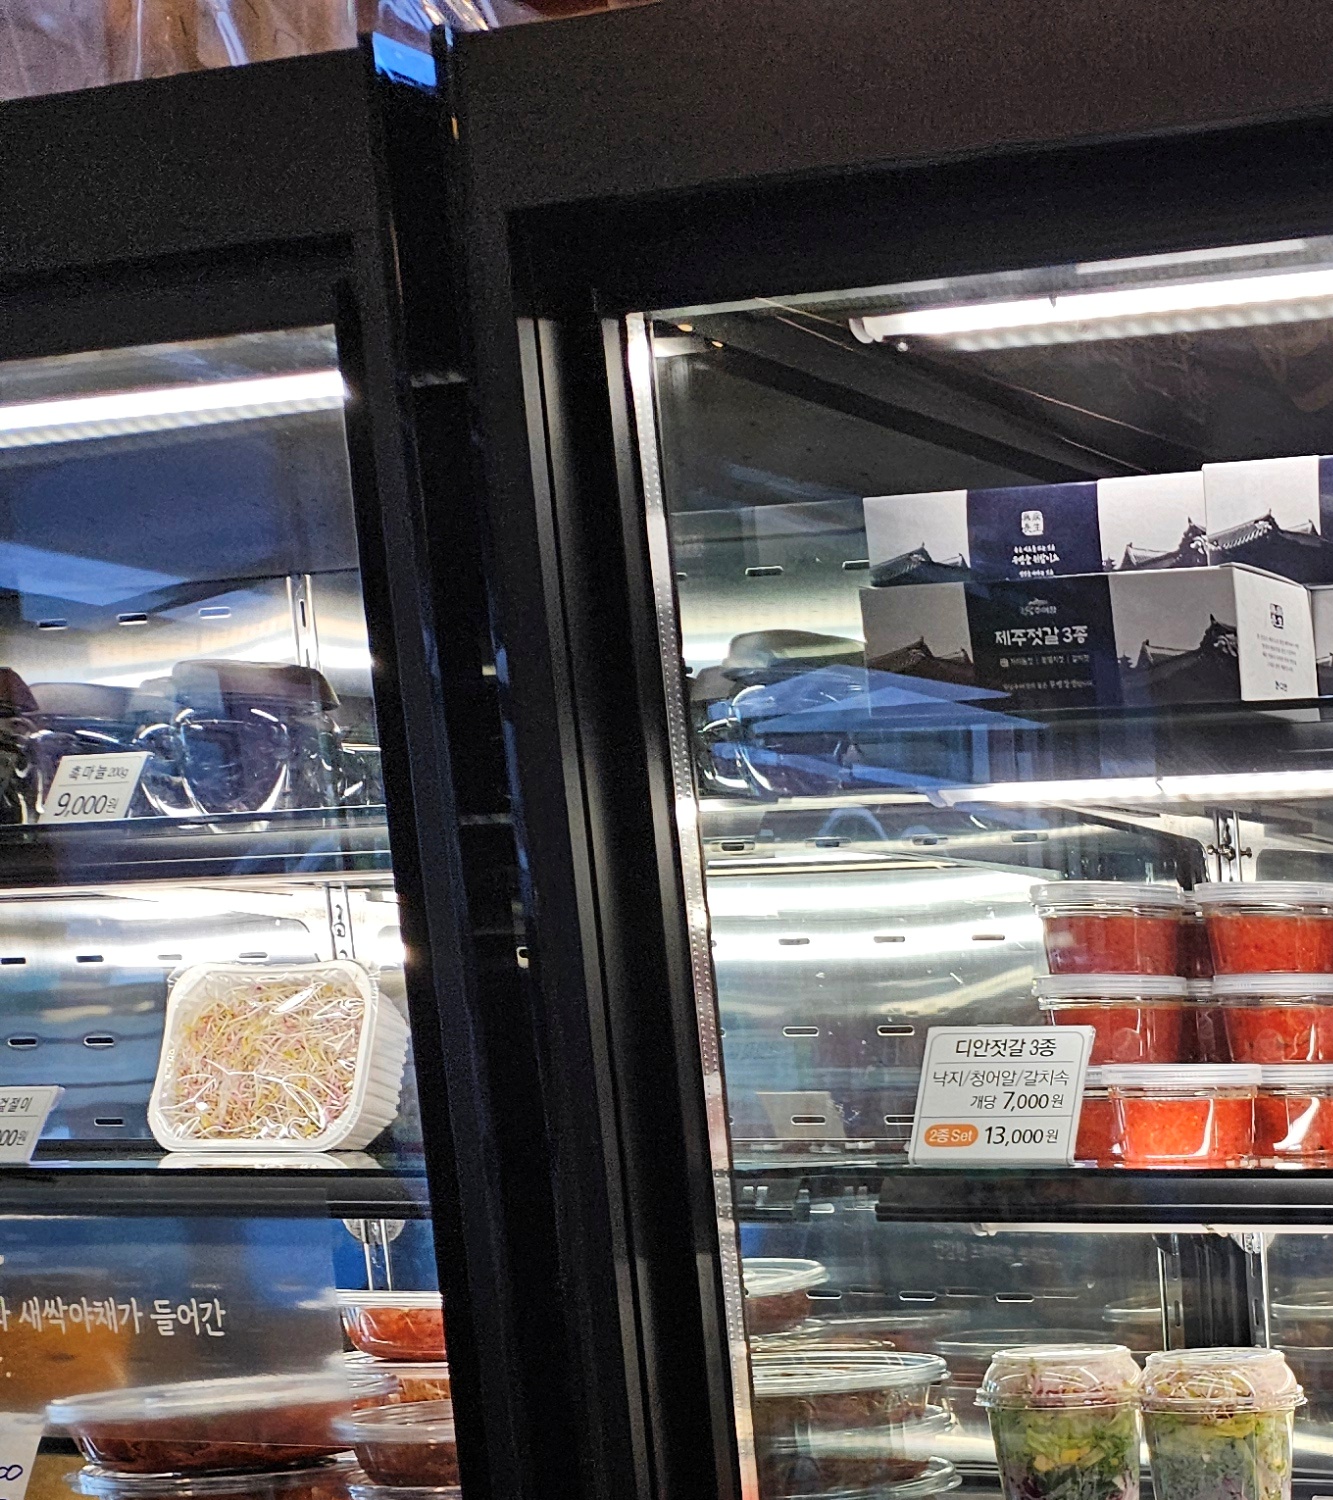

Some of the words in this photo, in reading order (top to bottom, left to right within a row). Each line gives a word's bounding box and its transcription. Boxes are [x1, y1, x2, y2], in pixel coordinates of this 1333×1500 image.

[995, 627, 1059, 646] 제주젓갈
[1062, 625, 1088, 644] 3종
[54, 792, 119, 817] 9,000원
[956, 1038, 1026, 1058] 디안젓갈
[1030, 1038, 1057, 1057] 3종
[933, 1069, 1070, 1087] 낙지/청어알/갈치속
[970, 1095, 997, 1109] 개당
[1002, 1091, 1064, 1112] 7,000원
[985, 1126, 1059, 1147] 13,000원
[19, 1296, 143, 1335] 새싹야채가
[150, 1298, 226, 1337] 들어간
